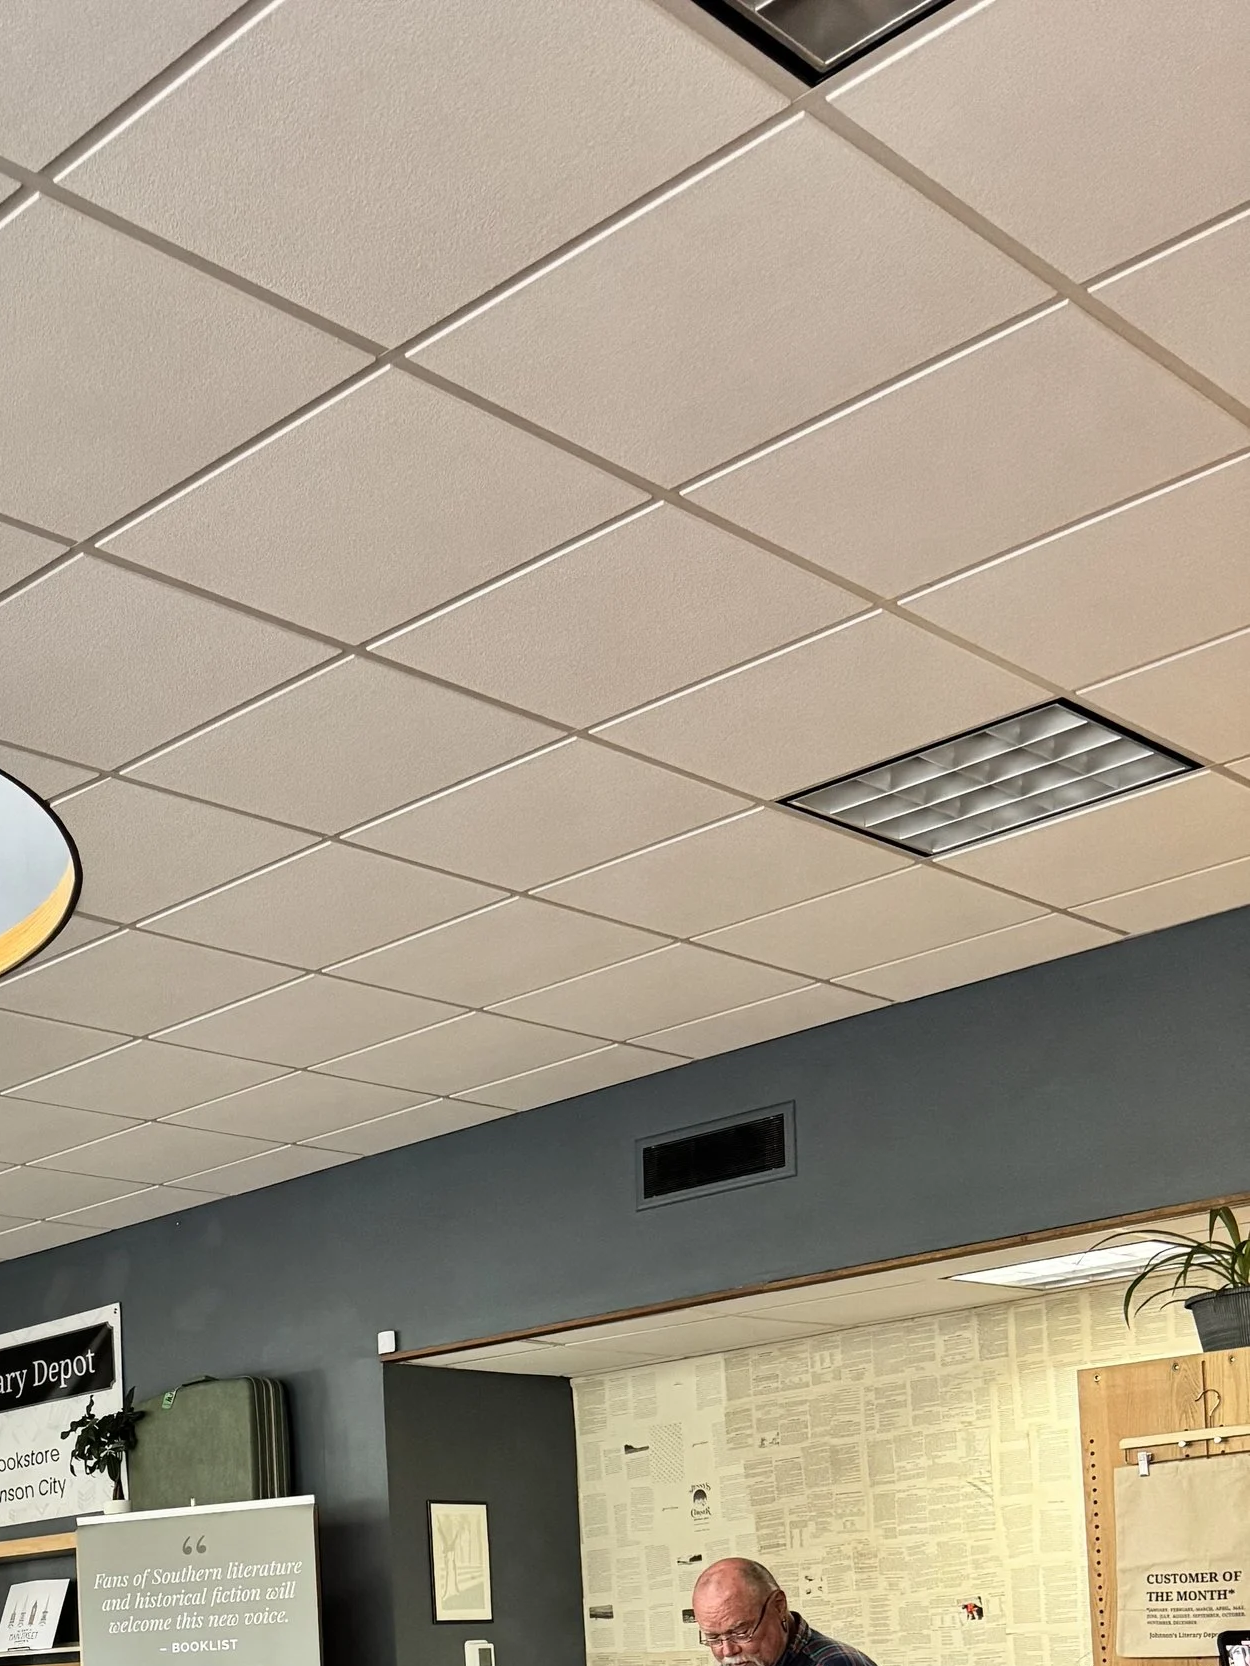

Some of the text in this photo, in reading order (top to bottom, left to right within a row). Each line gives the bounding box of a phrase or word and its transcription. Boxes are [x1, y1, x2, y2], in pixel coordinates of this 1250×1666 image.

[32, 1348, 95, 1389] Depot
[38, 1477, 66, 1499] City
[94, 1559, 303, 1589] Fans of Southern literature
[1146, 1570, 1242, 1585] CUSTOMER OF
[102, 1581, 296, 1611] and historical fiction will
[1146, 1591, 1174, 1602] THE
[108, 1607, 289, 1634] welcome this new voice.
[172, 1638, 238, 1654] BOOKLIST
